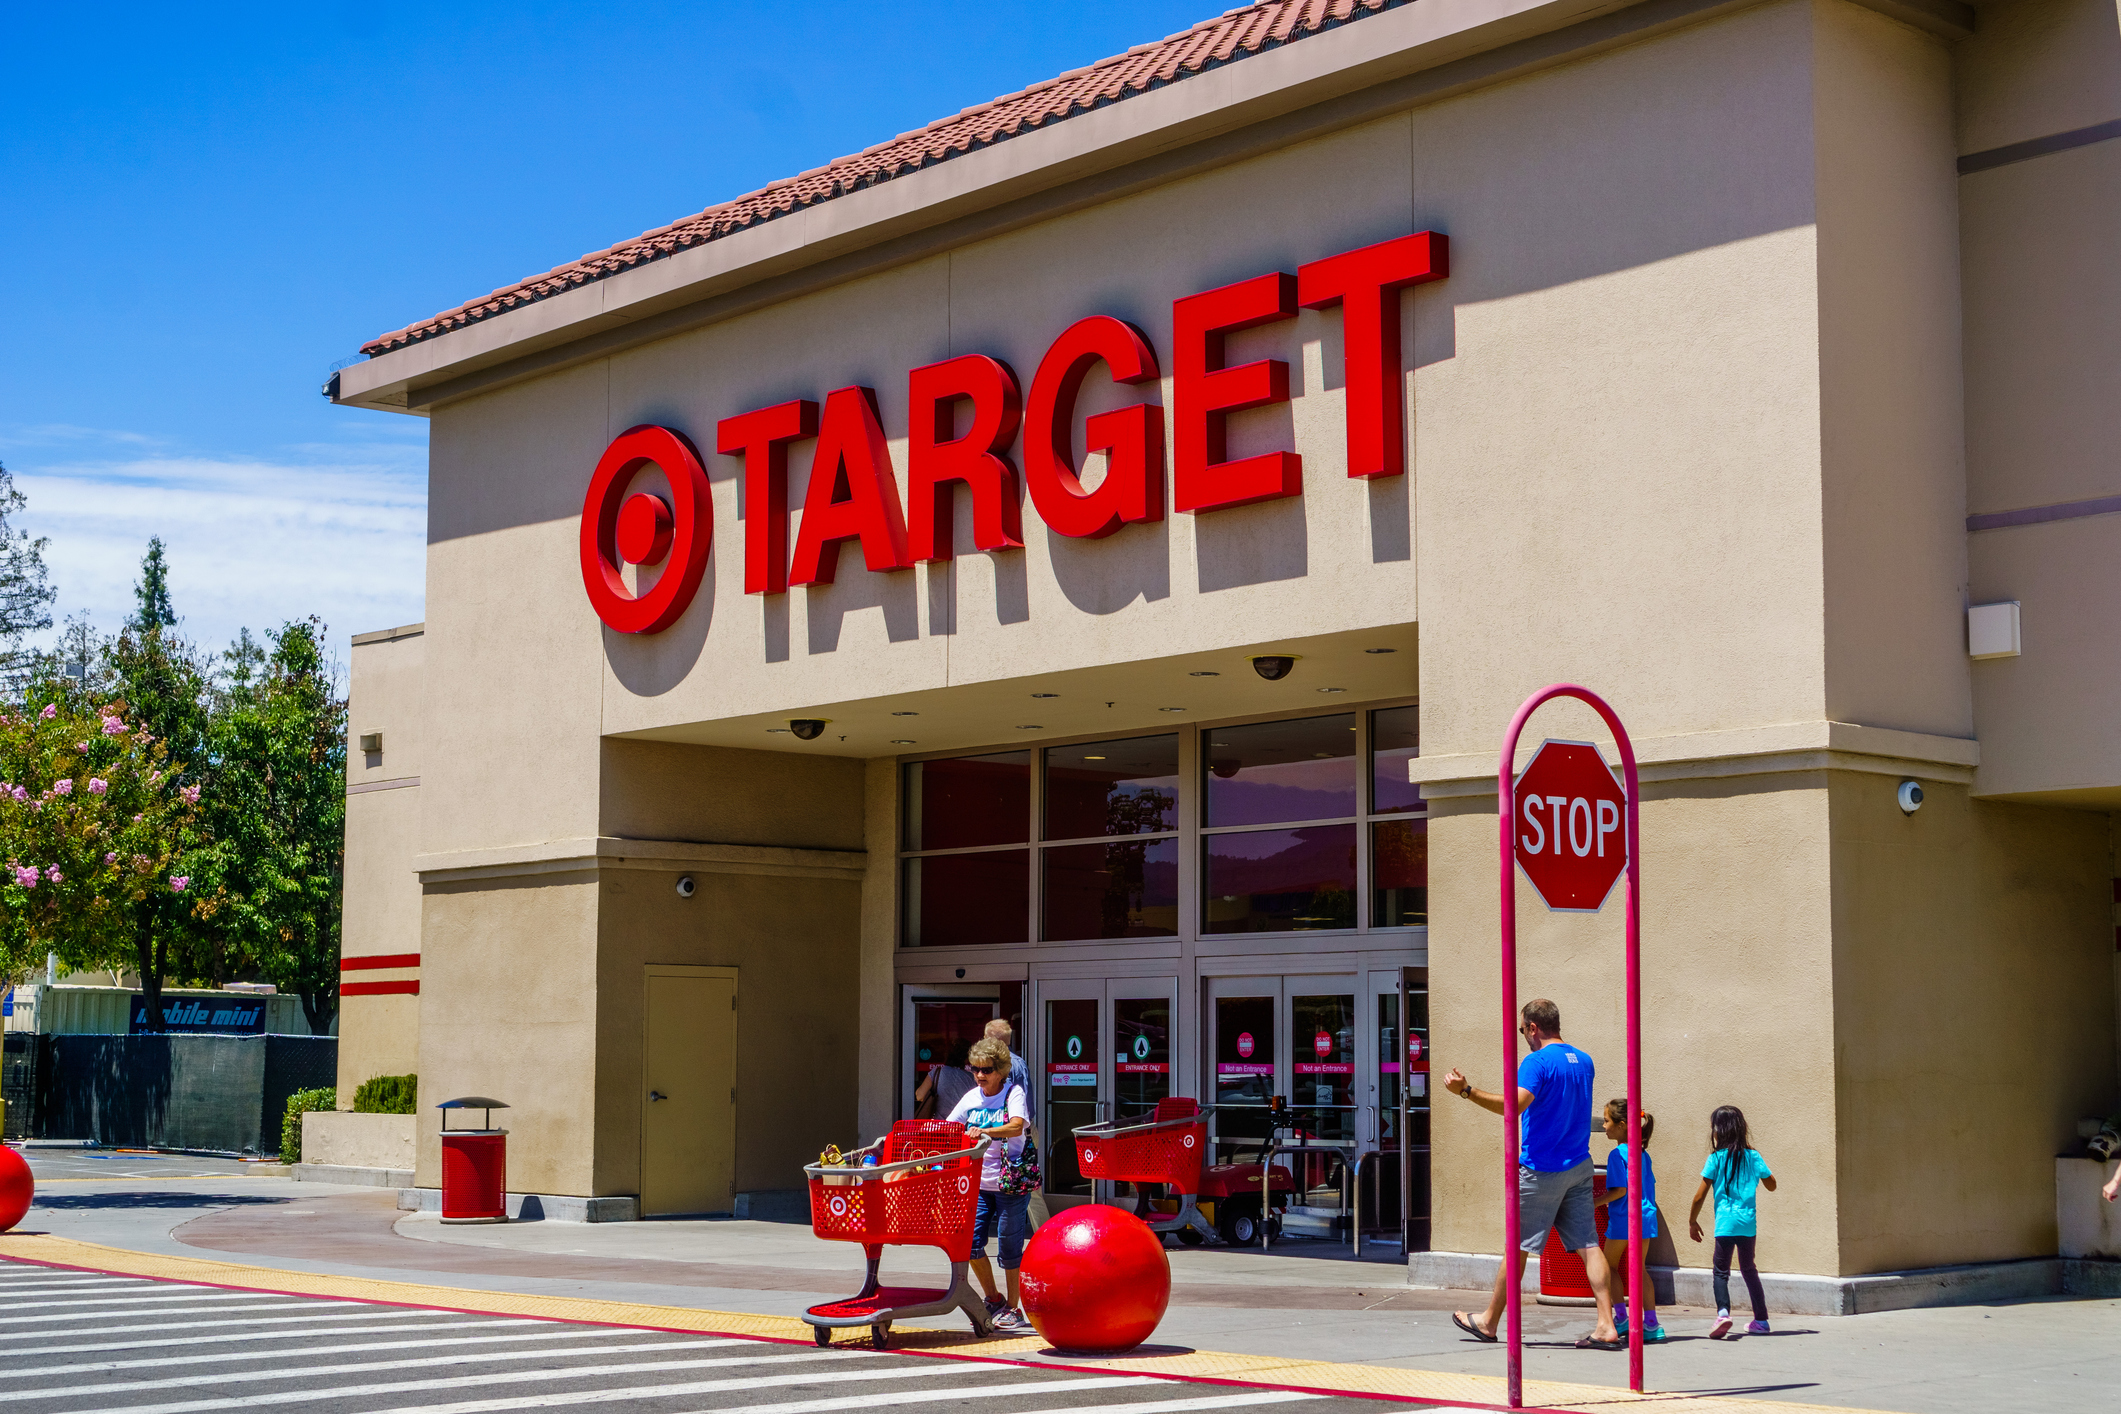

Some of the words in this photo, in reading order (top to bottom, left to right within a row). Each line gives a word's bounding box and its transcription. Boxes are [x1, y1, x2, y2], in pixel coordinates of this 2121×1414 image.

[717, 230, 1450, 595] TARGET
[1522, 793, 1619, 858] STOP
[210, 1006, 260, 1026] mini
[1225, 1064, 1235, 1072] Not
[1243, 1065, 1267, 1073] Entrance
[1302, 1064, 1313, 1072] Not
[1322, 1064, 1347, 1072] Entrance
